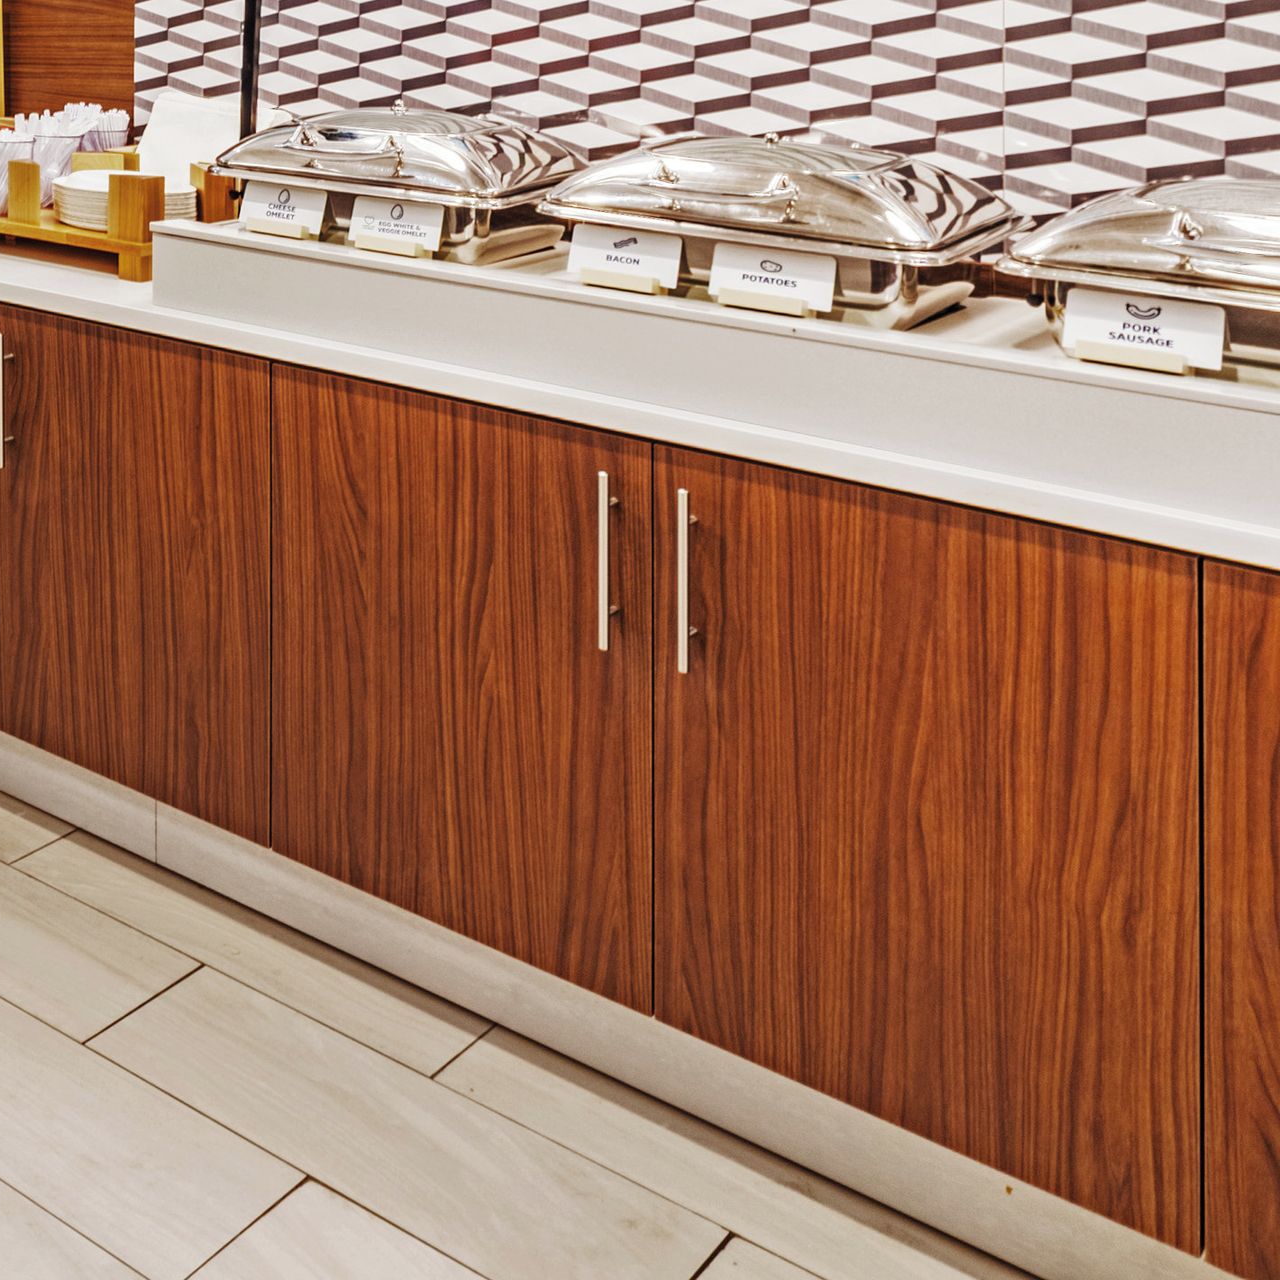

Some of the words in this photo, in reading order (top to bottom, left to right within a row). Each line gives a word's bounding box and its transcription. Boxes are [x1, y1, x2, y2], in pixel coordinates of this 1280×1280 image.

[268, 203, 296, 213] CHEESE
[265, 210, 295, 220] OMELET
[401, 230, 427, 238] OMELET
[606, 254, 640, 266] BACON
[742, 273, 798, 288] POTATOES
[1122, 322, 1161, 334] PORK
[1108, 331, 1174, 349] SAUSAGE
